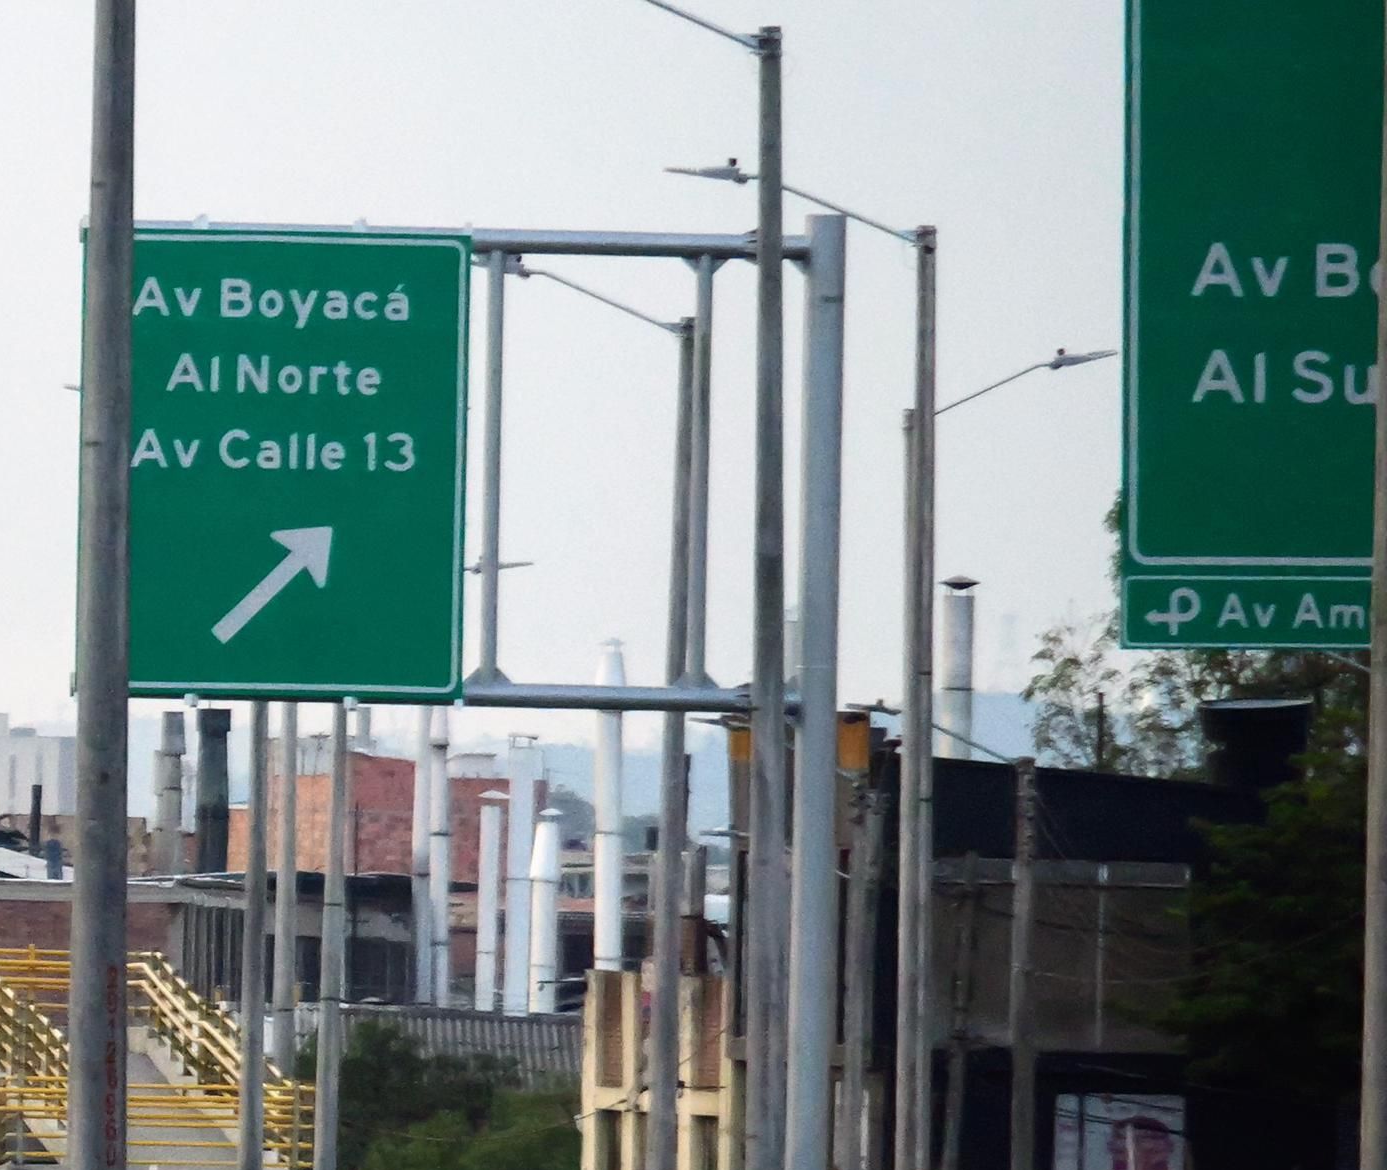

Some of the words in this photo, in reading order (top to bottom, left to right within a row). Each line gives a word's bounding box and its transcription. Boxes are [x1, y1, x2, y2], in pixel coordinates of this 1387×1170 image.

[1192, 242, 1288, 297] Av
[1316, 243, 1379, 297] B
[132, 276, 202, 317] Av
[220, 278, 409, 329] Boyacá
[165, 353, 220, 393] Al
[237, 355, 382, 396] Norte
[1192, 349, 1267, 403] Al
[130, 428, 200, 468] Av
[219, 429, 346, 470] Calle
[363, 432, 415, 472] 13
[1217, 592, 1276, 628] Av
